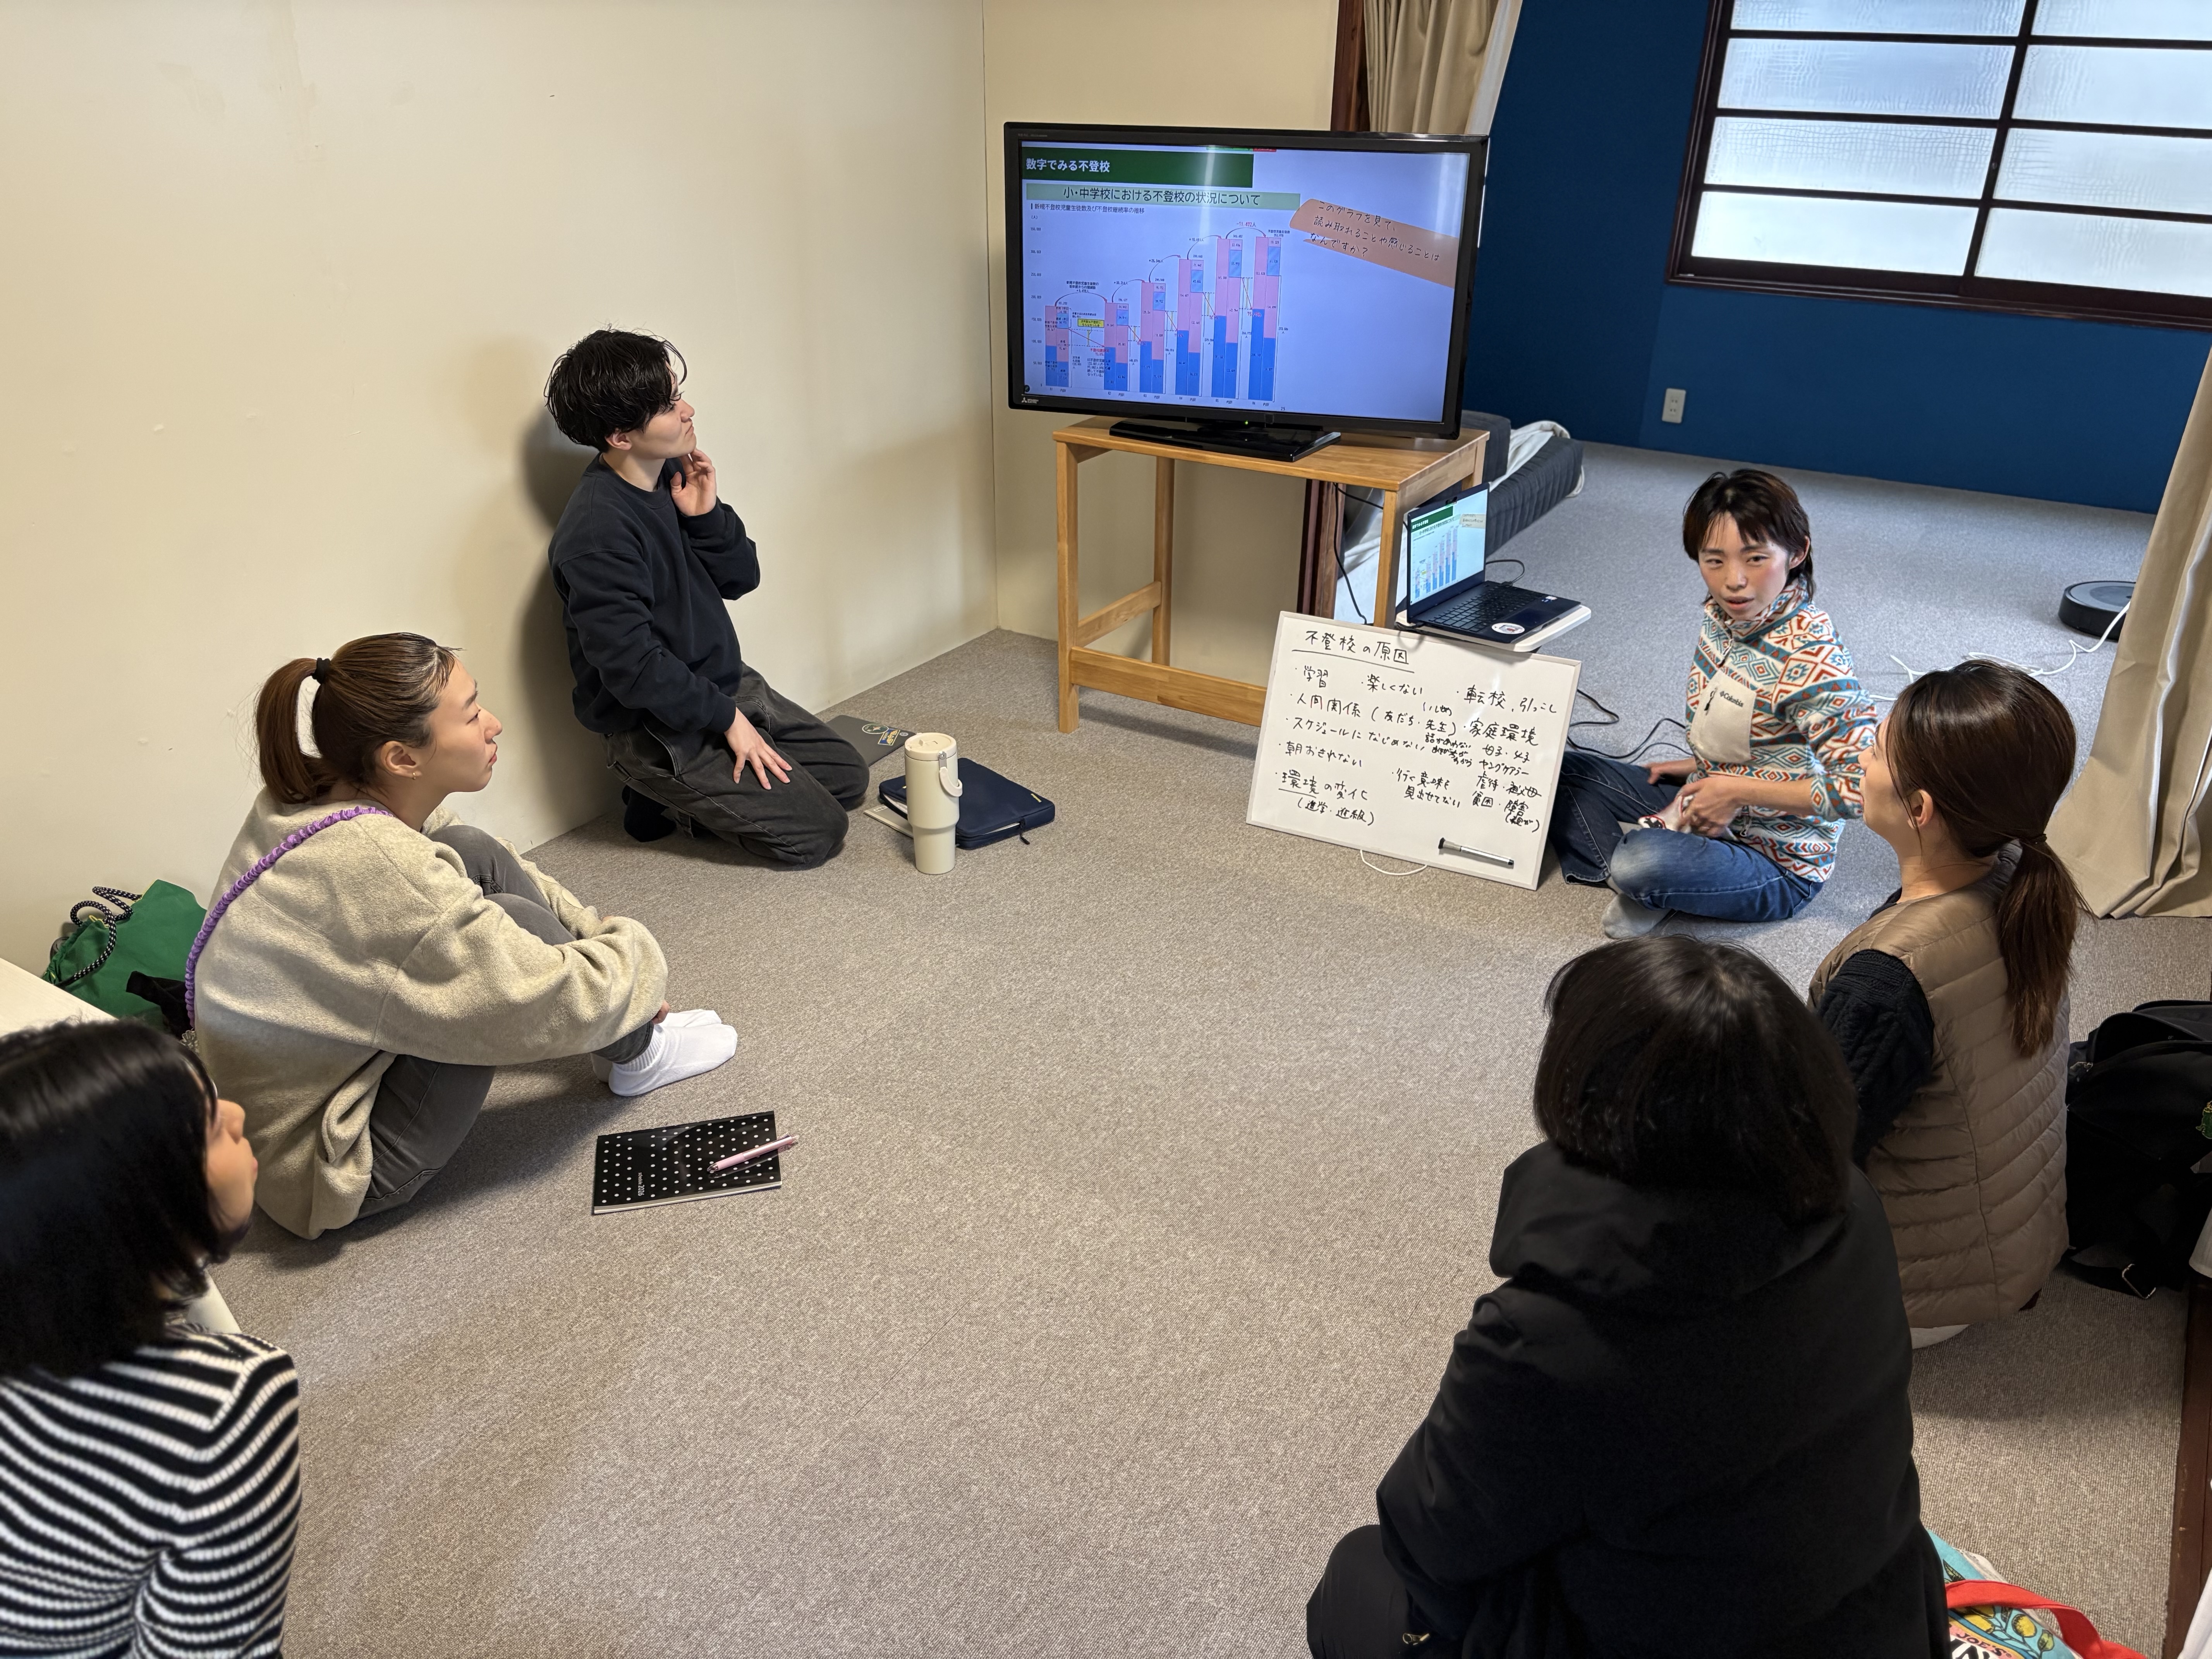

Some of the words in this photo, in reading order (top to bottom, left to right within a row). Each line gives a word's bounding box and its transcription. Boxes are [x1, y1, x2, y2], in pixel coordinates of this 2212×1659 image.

[1026, 158, 1110, 172] 数字でみる不登校
[1064, 186, 1260, 205] 小・中学校における不登校の状況について
[1314, 215, 1440, 261] 読み取れることや感じることは
[1305, 630, 1409, 665] 不登校の原因
[1304, 665, 1328, 688] 学習
[1367, 673, 1423, 695] 楽しくない
[1469, 717, 1539, 746] 家庭環境
[1285, 740, 1362, 767] 朝おきれない
[1479, 759, 1529, 776] ヤングケアラー
[1281, 769, 1368, 800] 環境の変化
[1404, 785, 1460, 808] 見出せてない
[1956, 1633, 2008, 1657] JOE'S
